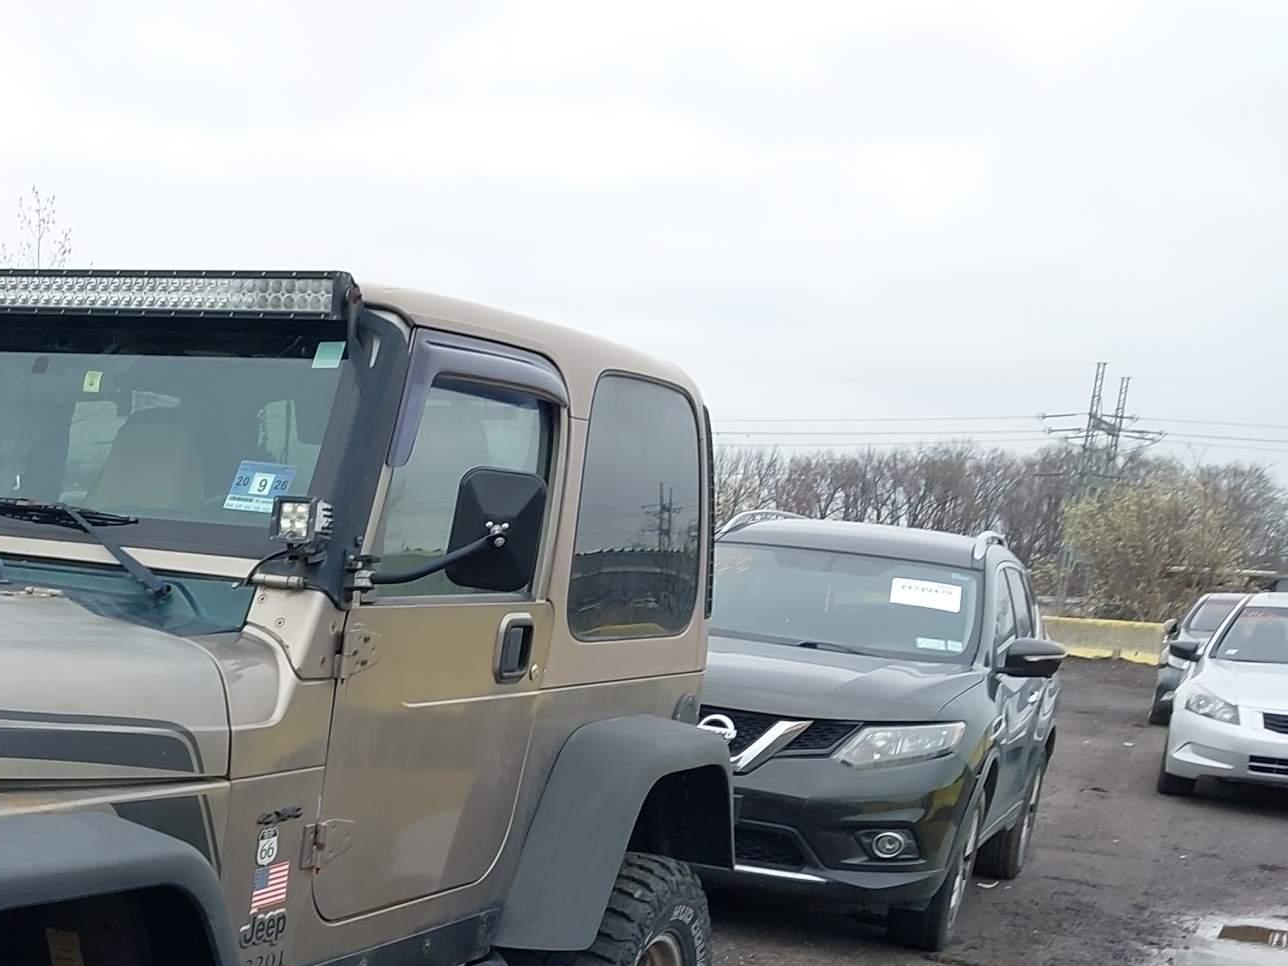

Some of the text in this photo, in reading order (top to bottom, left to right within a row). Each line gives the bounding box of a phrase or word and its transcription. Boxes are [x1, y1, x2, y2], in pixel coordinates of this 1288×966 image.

[235, 475, 250, 487] 20
[257, 478, 268, 493] 9
[259, 841, 275, 860] 66
[241, 913, 286, 946] Jeep
